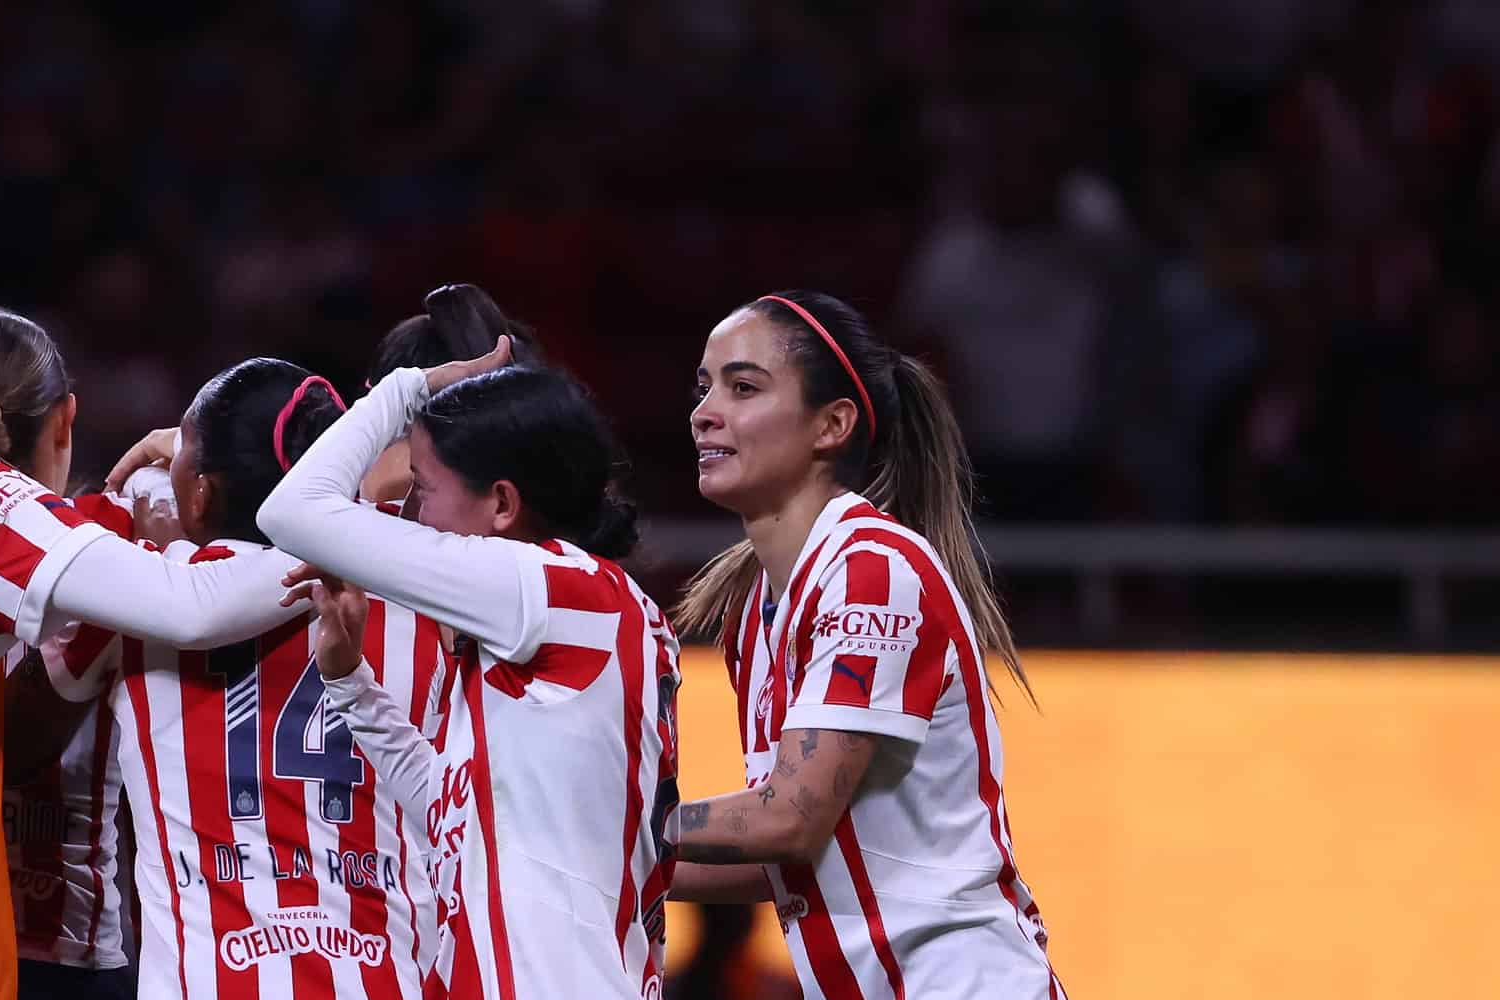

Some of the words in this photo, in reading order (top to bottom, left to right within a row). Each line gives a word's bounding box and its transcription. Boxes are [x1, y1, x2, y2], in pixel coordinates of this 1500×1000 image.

[842, 611, 911, 638] GNP
[208, 640, 365, 824] 14
[178, 850, 204, 888] J.
[214, 843, 255, 882] DE
[269, 845, 314, 881] LA
[326, 849, 399, 892] ROSA
[226, 925, 310, 966] CIELITO
[315, 926, 382, 962] LINDO
